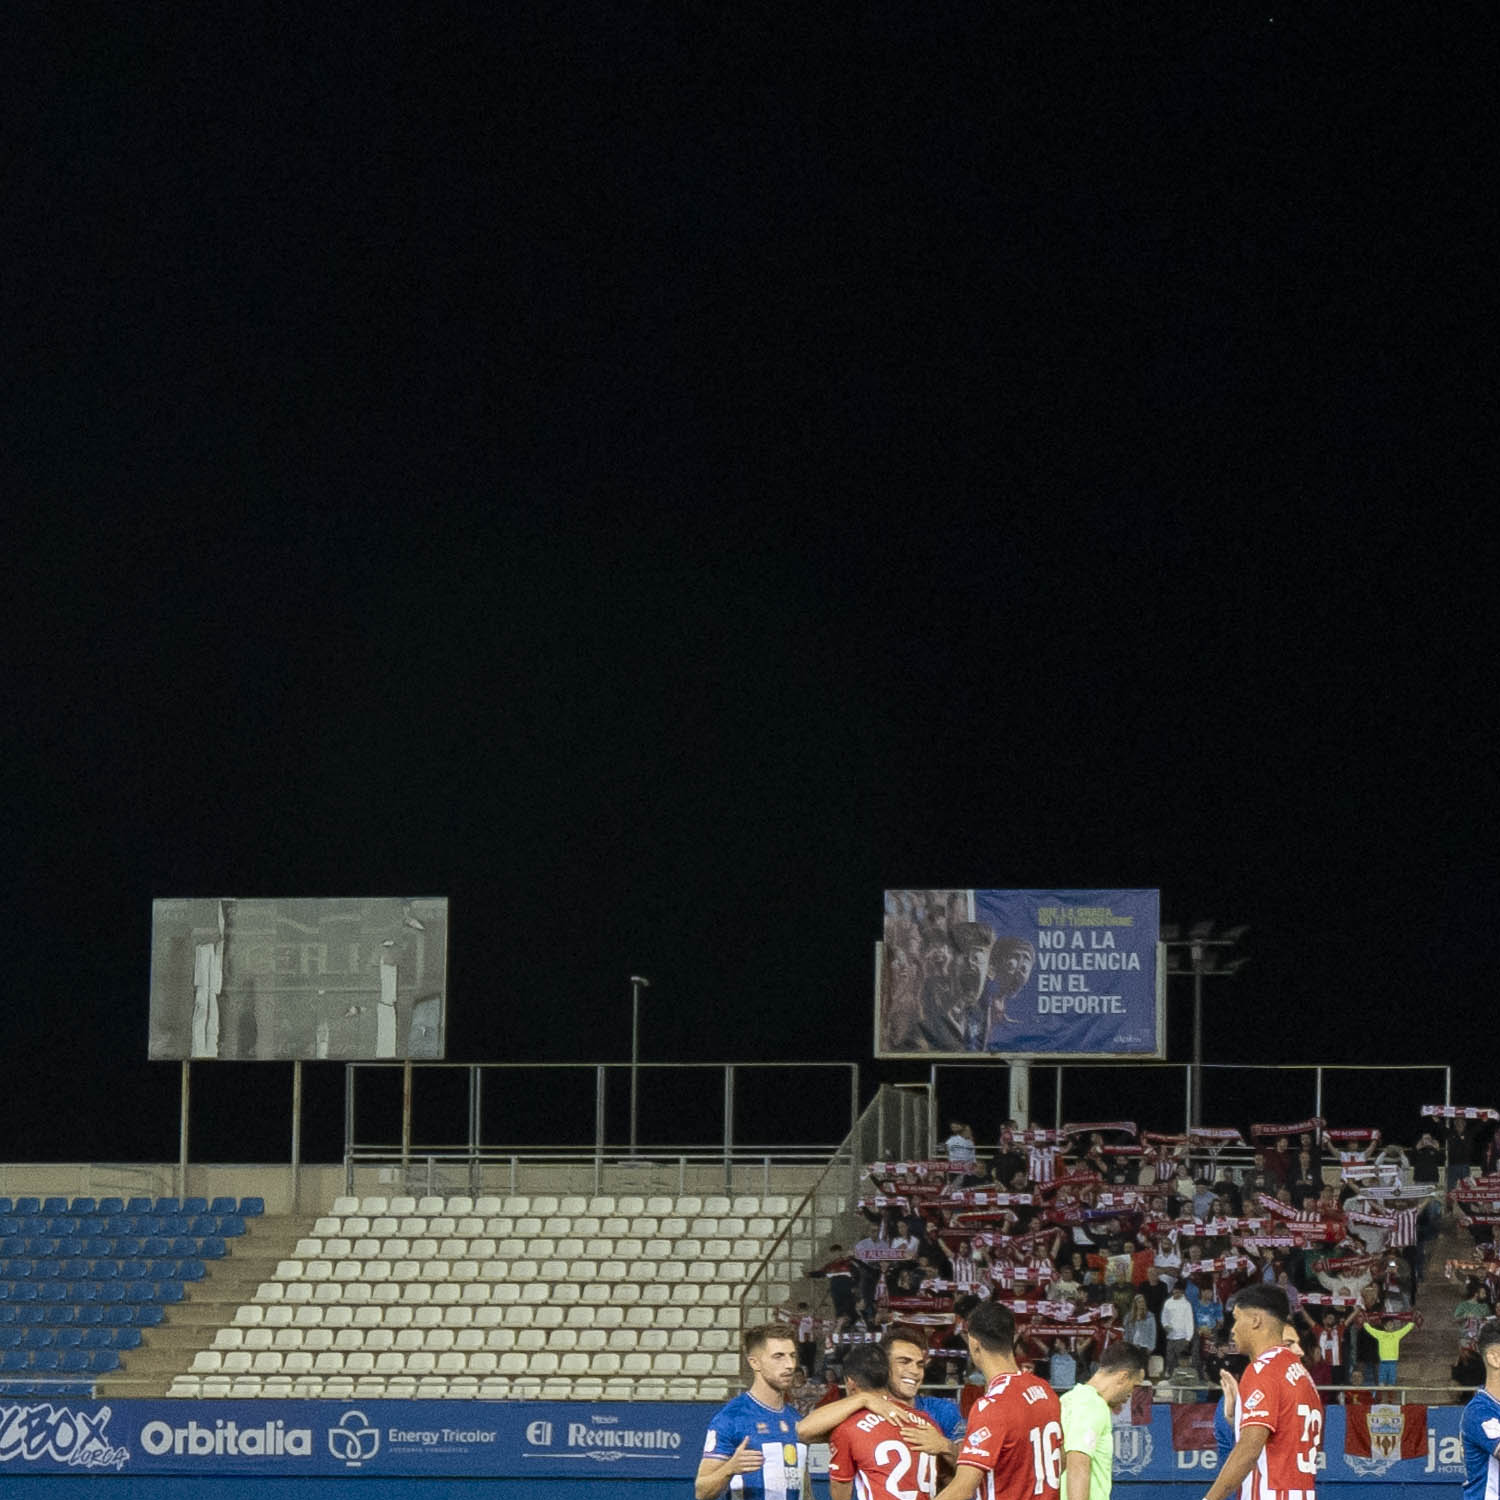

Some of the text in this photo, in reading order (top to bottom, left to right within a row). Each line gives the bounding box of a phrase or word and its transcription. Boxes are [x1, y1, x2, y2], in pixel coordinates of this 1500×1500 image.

[1038, 931, 1116, 949] NO A LA
[1038, 952, 1141, 971] VIOLENCIA
[1038, 973, 1090, 992] EN EL
[1038, 995, 1128, 1014] DEPORTE.
[140, 1419, 312, 1456] Orbitalia
[388, 1429, 497, 1446] Energy Tricolor
[526, 1420, 681, 1449] El Reencuentro
[68, 1446, 131, 1471] LORCA
[1029, 1420, 1062, 1495] 16
[1438, 1465, 1466, 1474] HOTE
